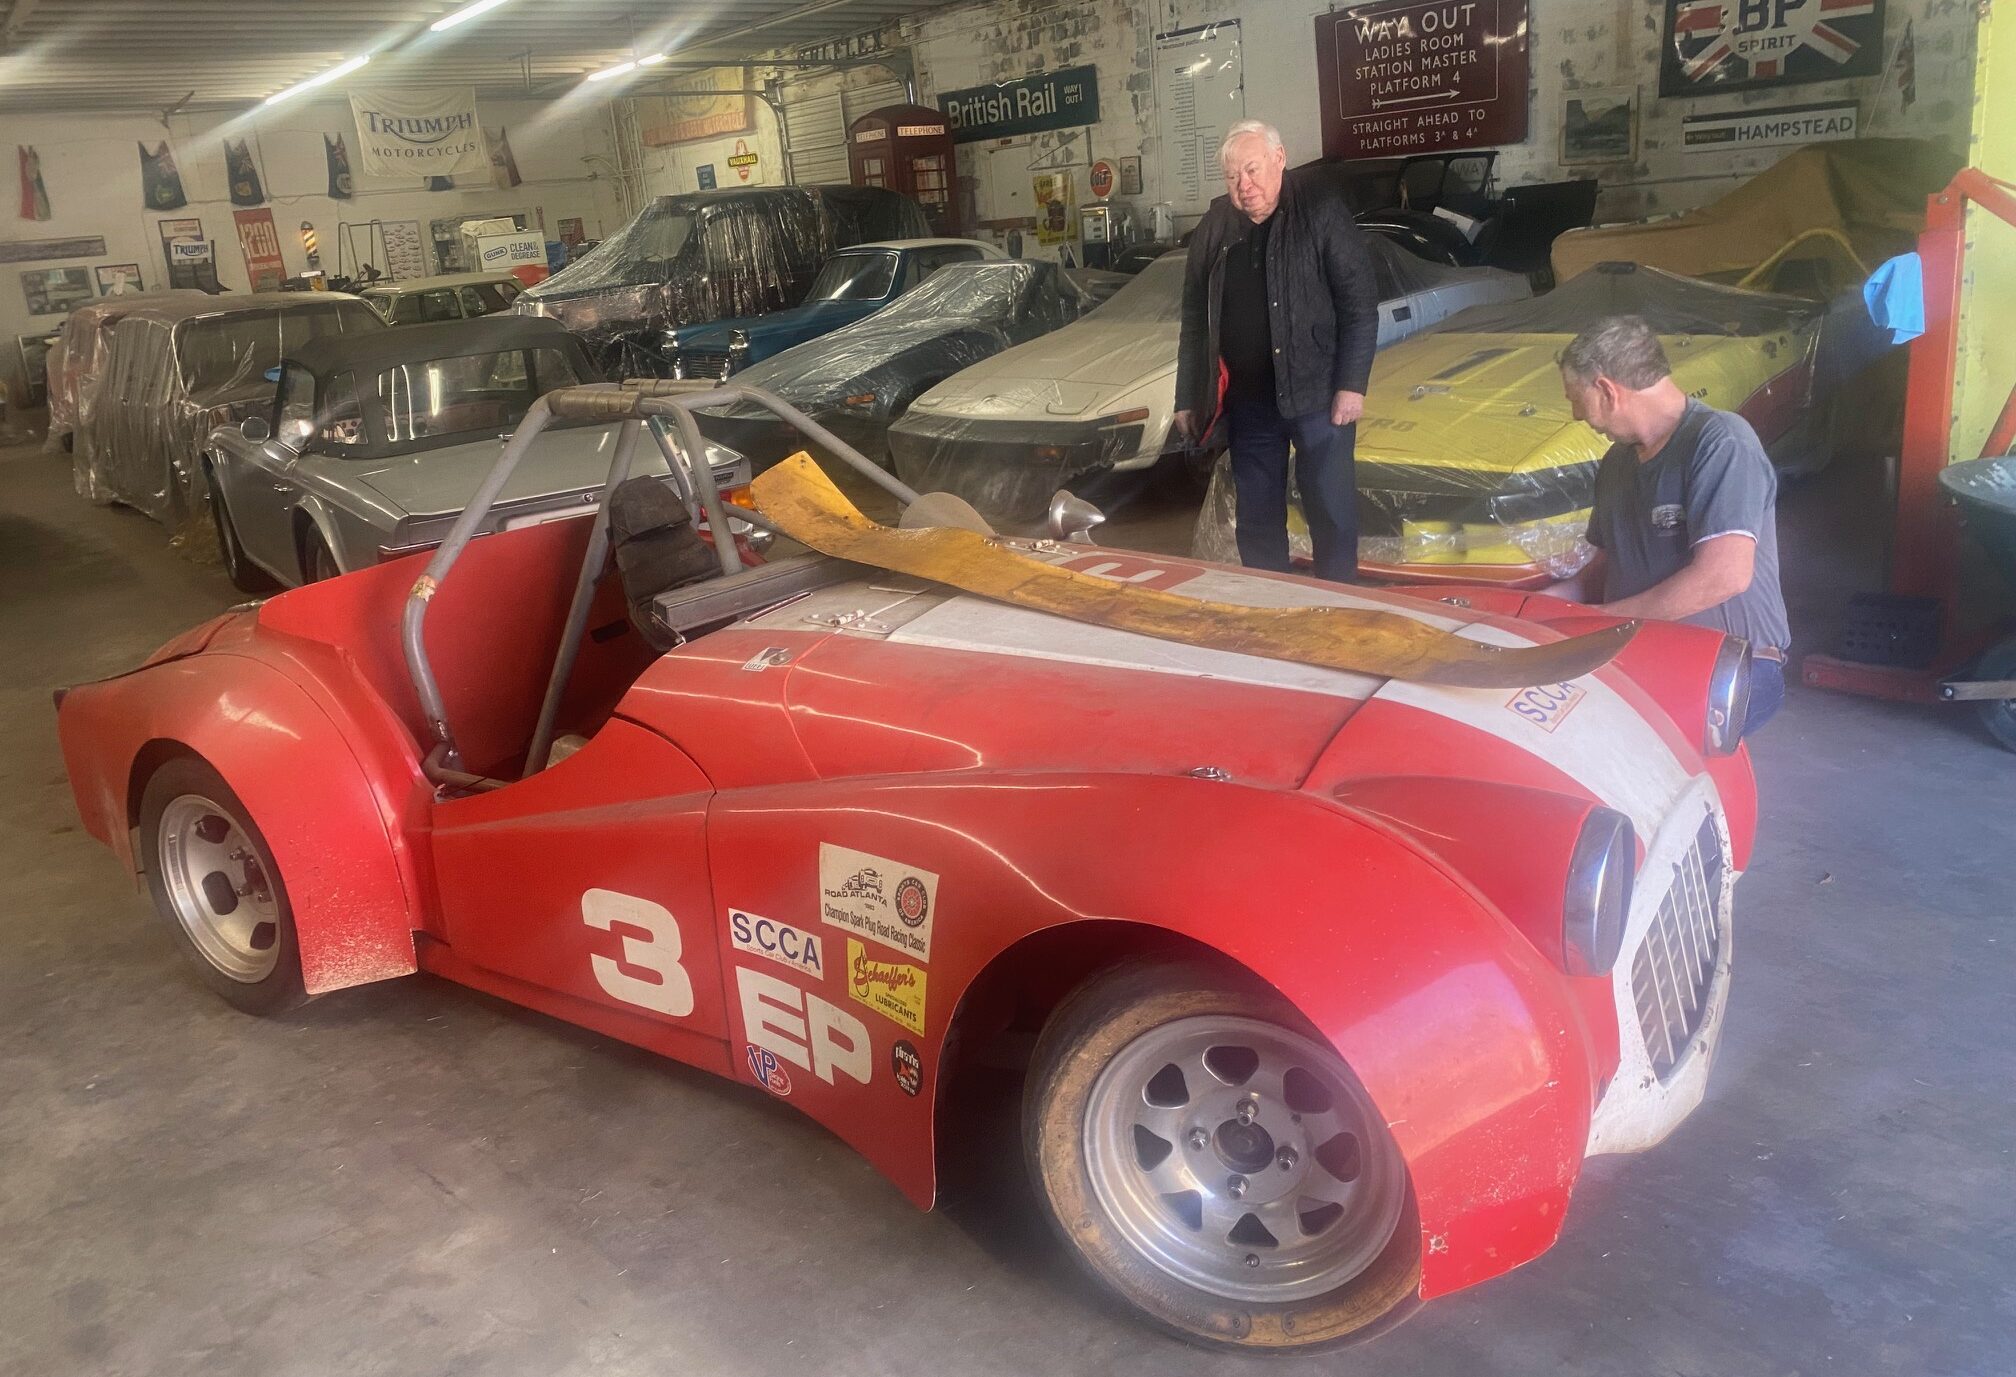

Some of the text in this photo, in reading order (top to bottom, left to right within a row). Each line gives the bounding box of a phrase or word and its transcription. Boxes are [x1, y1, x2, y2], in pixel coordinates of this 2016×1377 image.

[1354, 4, 1476, 45] WAY OUT
[1365, 33, 1464, 62] LADIES ROOM
[1738, 34, 1797, 52] SPIRIT
[1355, 50, 1478, 80] STATION MASTER
[1063, 84, 1078, 94] WAY
[1370, 70, 1461, 95] PLATFORM 4
[948, 82, 1057, 129] British Rail
[1065, 94, 1079, 104] OUT
[363, 111, 473, 134] TRIUMPH
[899, 127, 942, 135] TELEPHONE
[1352, 109, 1486, 135] STRAIGHT AHEAD TO
[1737, 116, 1854, 141] HAMPSTEAD
[372, 142, 476, 158] MOTORCYCLES
[1360, 132, 1425, 149] PLATFORMS
[1452, 130, 1459, 141] &
[729, 154, 757, 166] VAUXHALL
[173, 244, 209, 256] TRIUMPH
[509, 241, 533, 253] CLEAN
[510, 250, 541, 260] DEGREASE
[824, 888, 888, 908] ROAD ATLANTA
[824, 902, 926, 953] Champion Spark Plug Road Racing Classic
[581, 887, 695, 1017] 3
[732, 912, 821, 970] SCCA
[853, 954, 916, 992] Schaeffer's
[875, 993, 917, 1023] LUBRICANTS
[735, 965, 873, 1087] EP
[746, 1045, 778, 1088] VP
